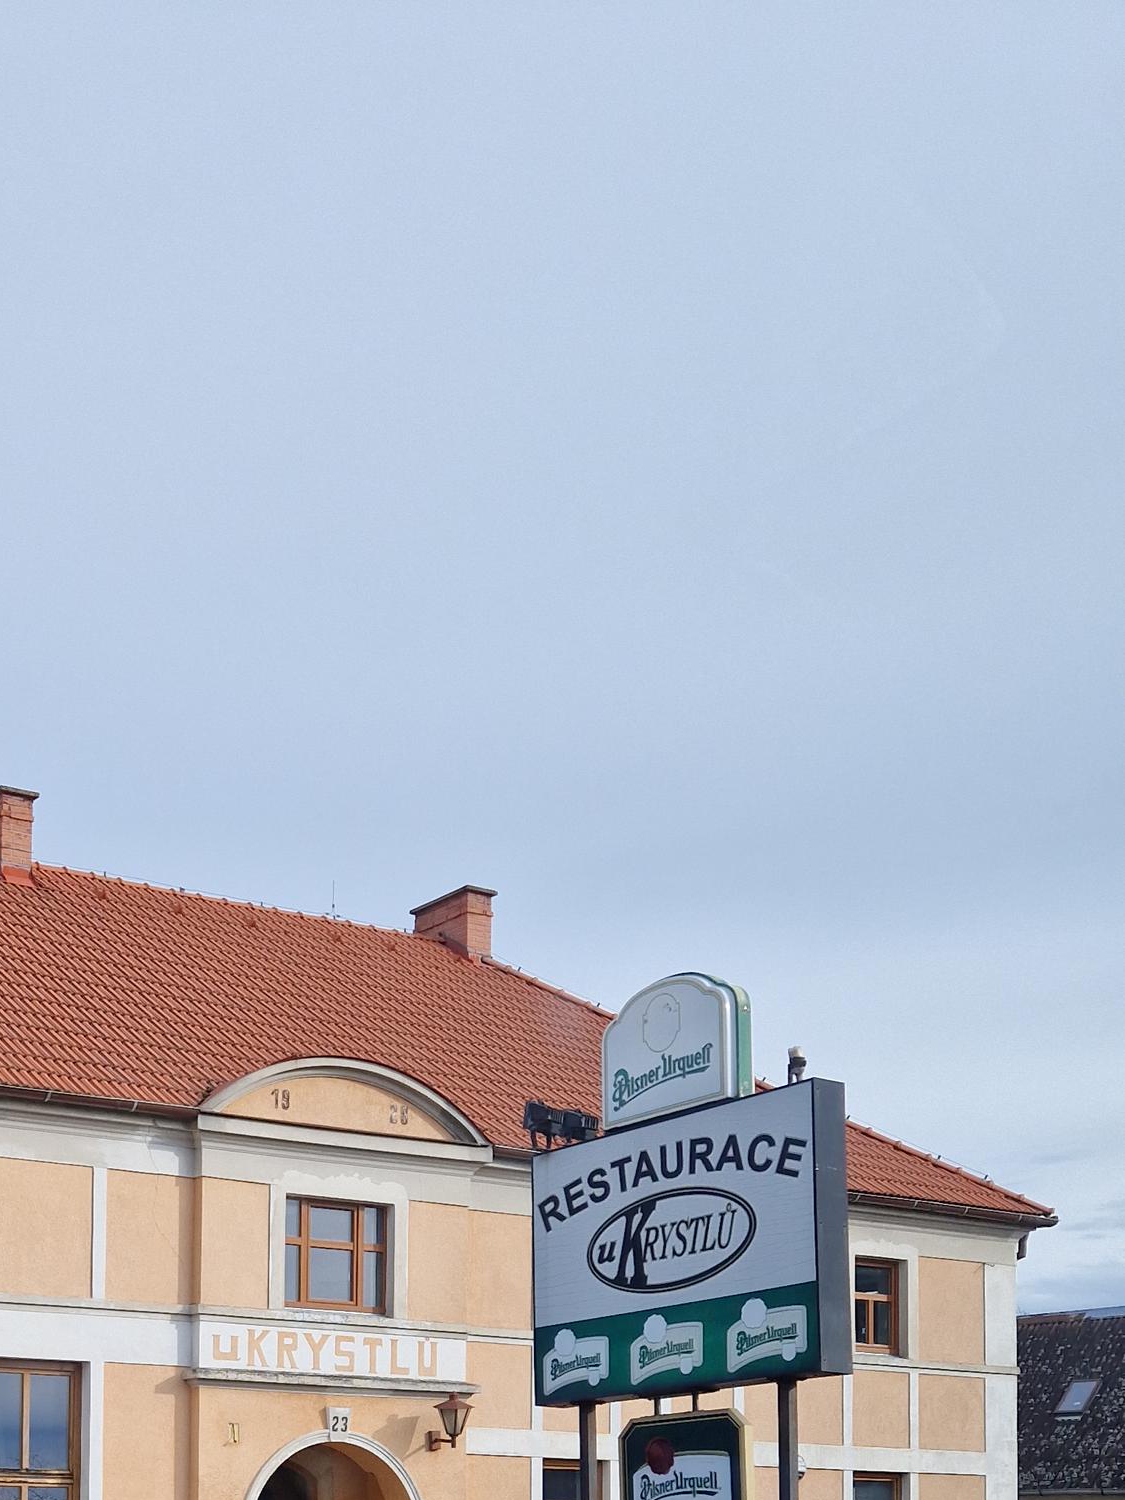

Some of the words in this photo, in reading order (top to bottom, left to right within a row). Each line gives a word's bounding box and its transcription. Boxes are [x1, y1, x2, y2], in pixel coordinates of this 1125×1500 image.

[612, 1068, 661, 1112] Pilsner
[661, 1042, 713, 1079] Urquell
[271, 1089, 290, 1110] 19
[537, 1133, 807, 1233] RESTAURACE
[639, 1345, 666, 1369] Pilsner
[666, 1338, 694, 1356] Urquell
[736, 1330, 766, 1356] Pilsner
[766, 1322, 797, 1342] Urquell
[550, 1358, 575, 1381] Pilsner
[575, 1352, 601, 1369] Urquell
[331, 1416, 349, 1433] 23
[674, 1470, 718, 1498] Urquell
